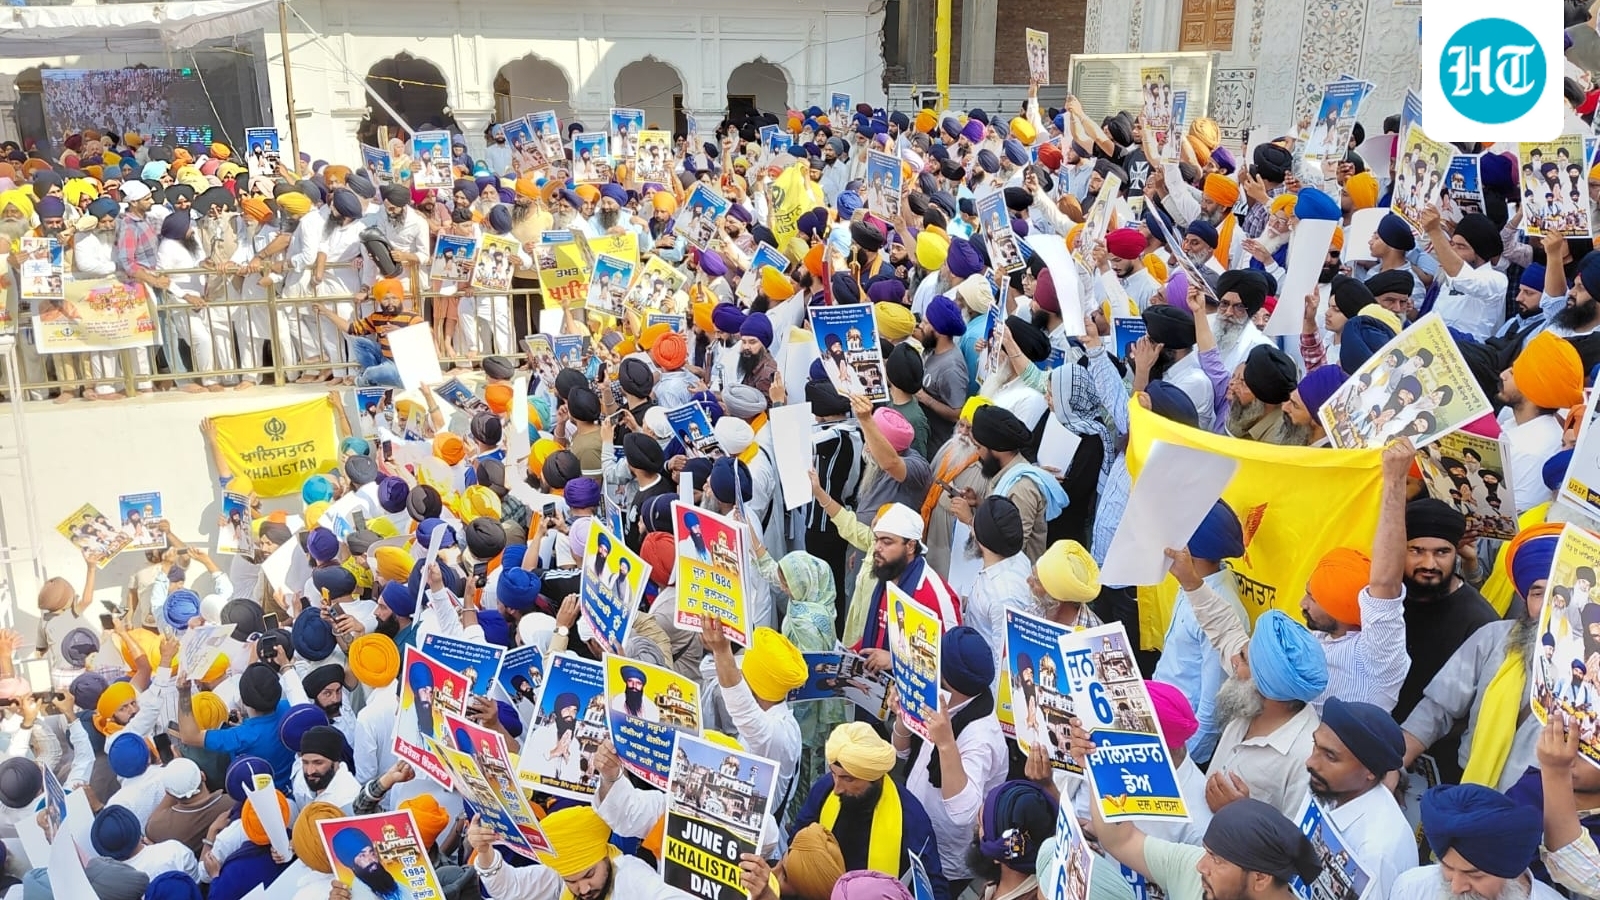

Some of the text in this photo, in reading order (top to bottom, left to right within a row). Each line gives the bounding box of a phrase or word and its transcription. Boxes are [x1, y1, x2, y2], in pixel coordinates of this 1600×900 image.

[243, 457, 317, 480] KHALISTAN
[1568, 481, 1586, 496] USSF
[710, 572, 732, 589] 1984
[1065, 648, 1095, 692] ਜੂਨ
[1088, 681, 1114, 725] 6
[1120, 767, 1153, 794] ਡੇਅ
[1136, 799, 1151, 811] ਦਲ
[681, 821, 738, 860] JUNE 6
[403, 866, 426, 878] 1984
[690, 873, 722, 900] DAY
